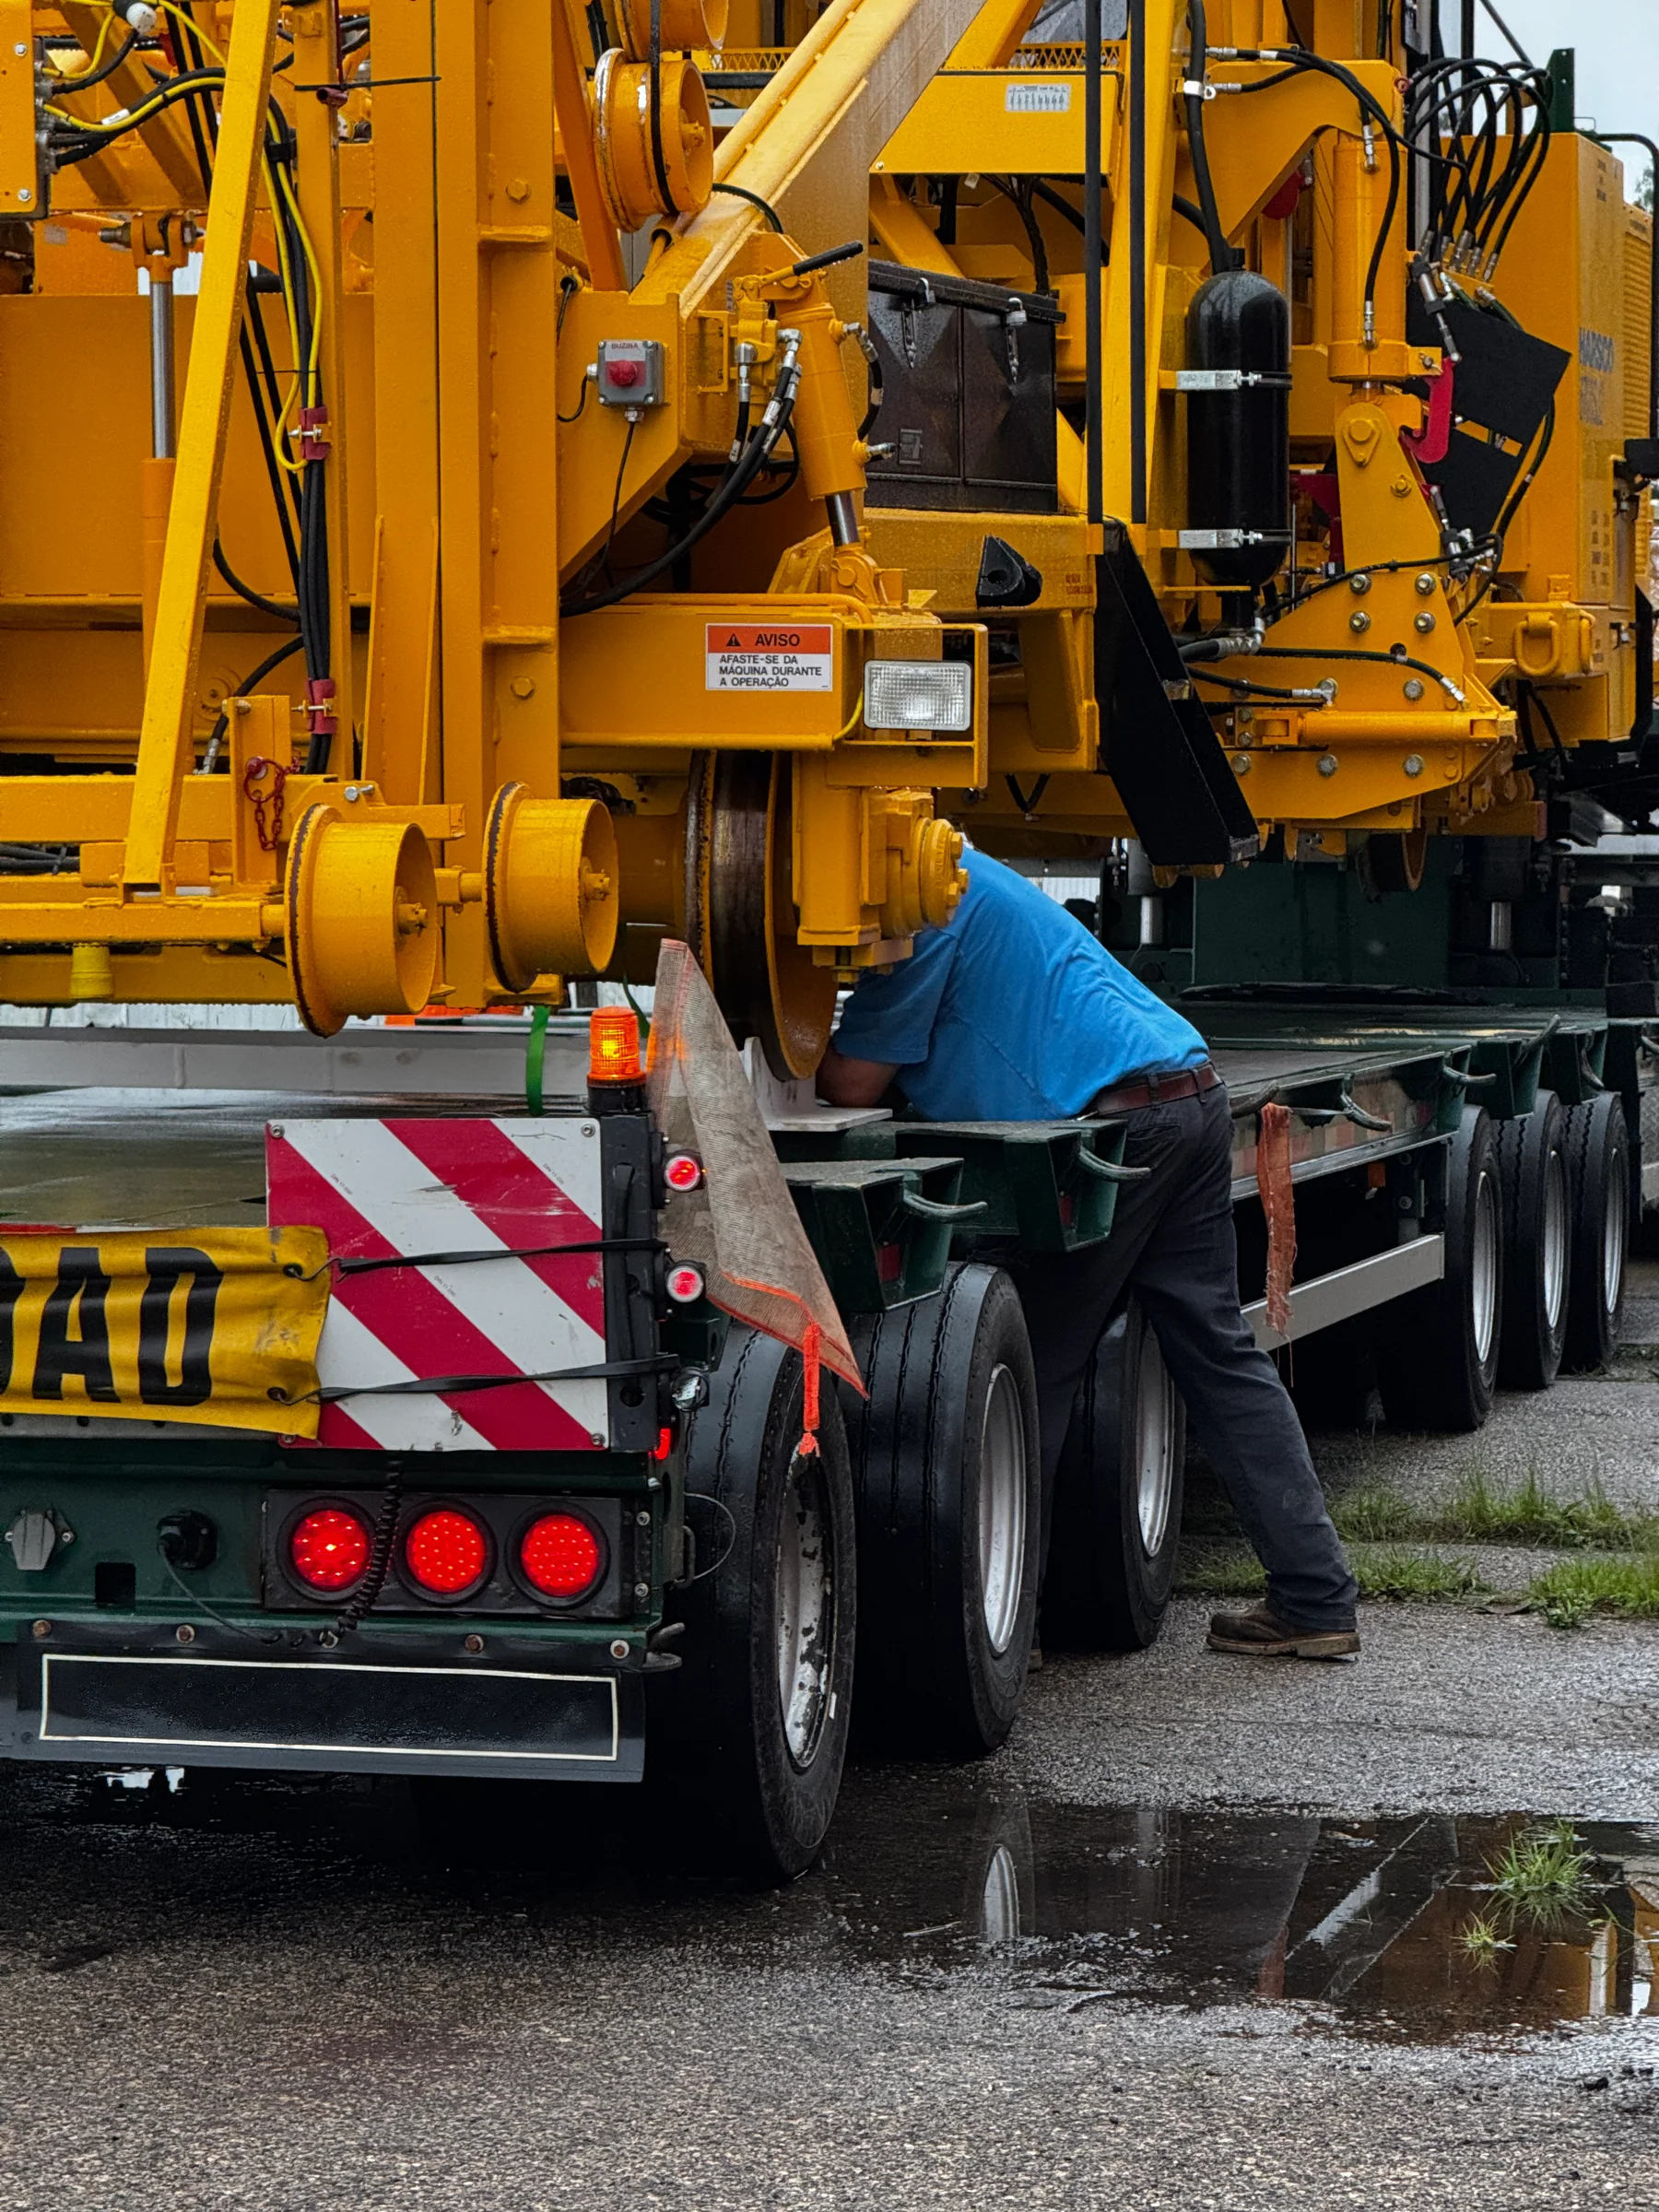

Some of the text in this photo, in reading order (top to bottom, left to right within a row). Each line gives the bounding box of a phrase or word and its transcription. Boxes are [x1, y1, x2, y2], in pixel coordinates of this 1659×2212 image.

[755, 633, 801, 647] AVISO
[719, 654, 798, 665] AFASTE-SE DA
[719, 665, 822, 676] MÁQUINA DURANTE
[719, 676, 789, 688] A OPERAÇÃO
